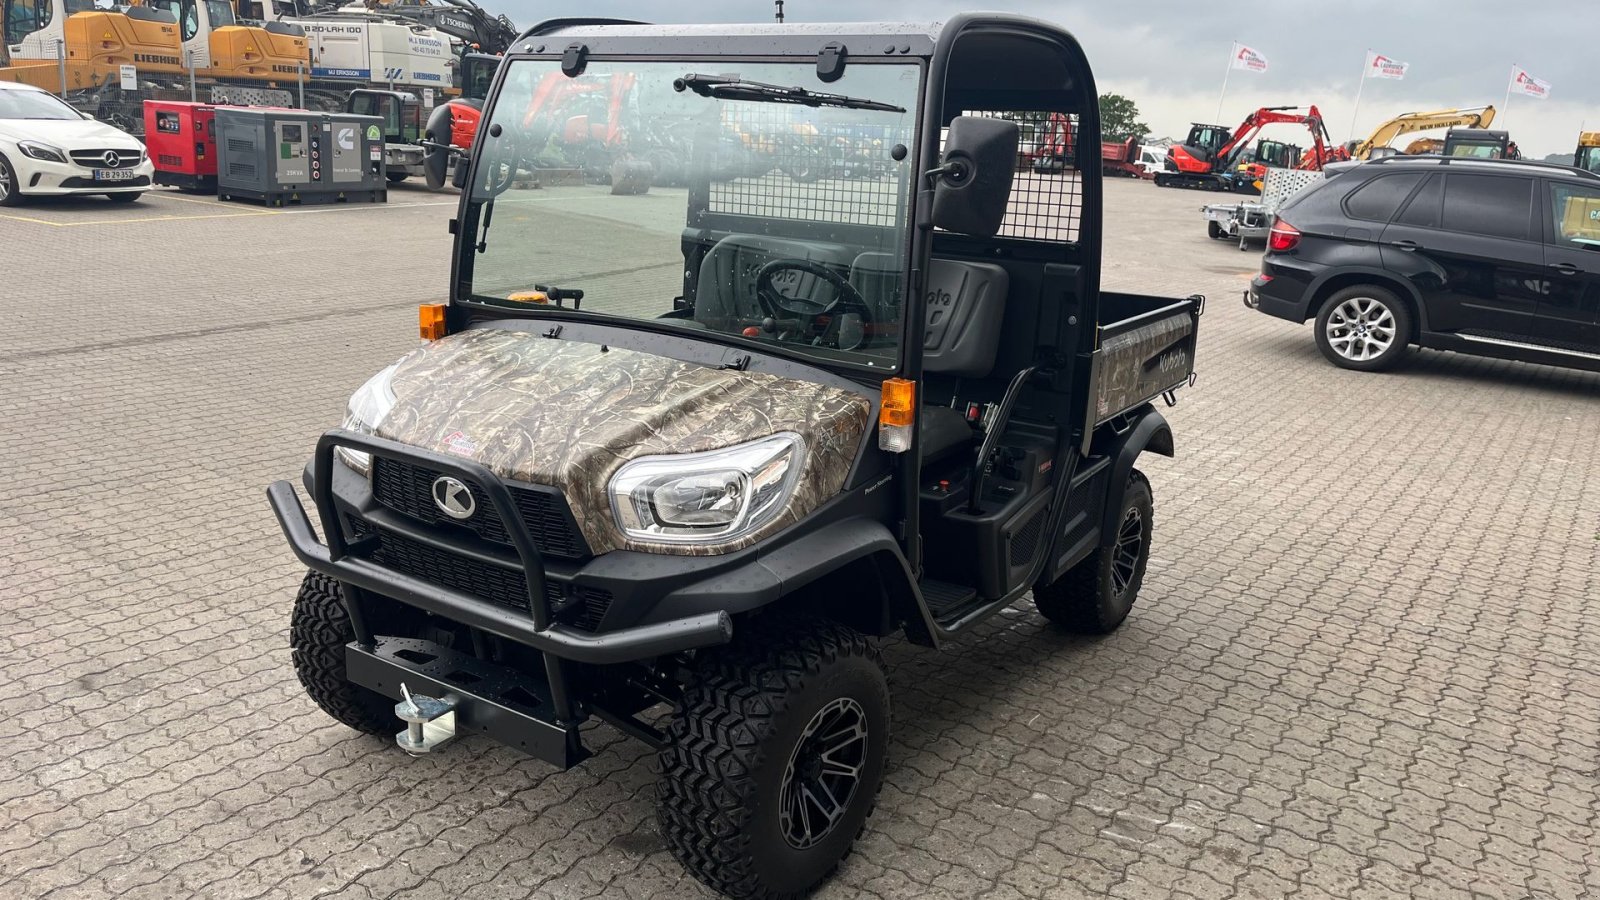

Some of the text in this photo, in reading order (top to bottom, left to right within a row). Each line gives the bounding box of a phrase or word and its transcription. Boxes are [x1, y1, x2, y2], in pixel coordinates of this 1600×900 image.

[413, 72, 441, 81] LIEBHERR
[1434, 120, 1462, 129] HOLLAND
[100, 171, 111, 179] EB
[1159, 347, 1186, 373] Kubota
